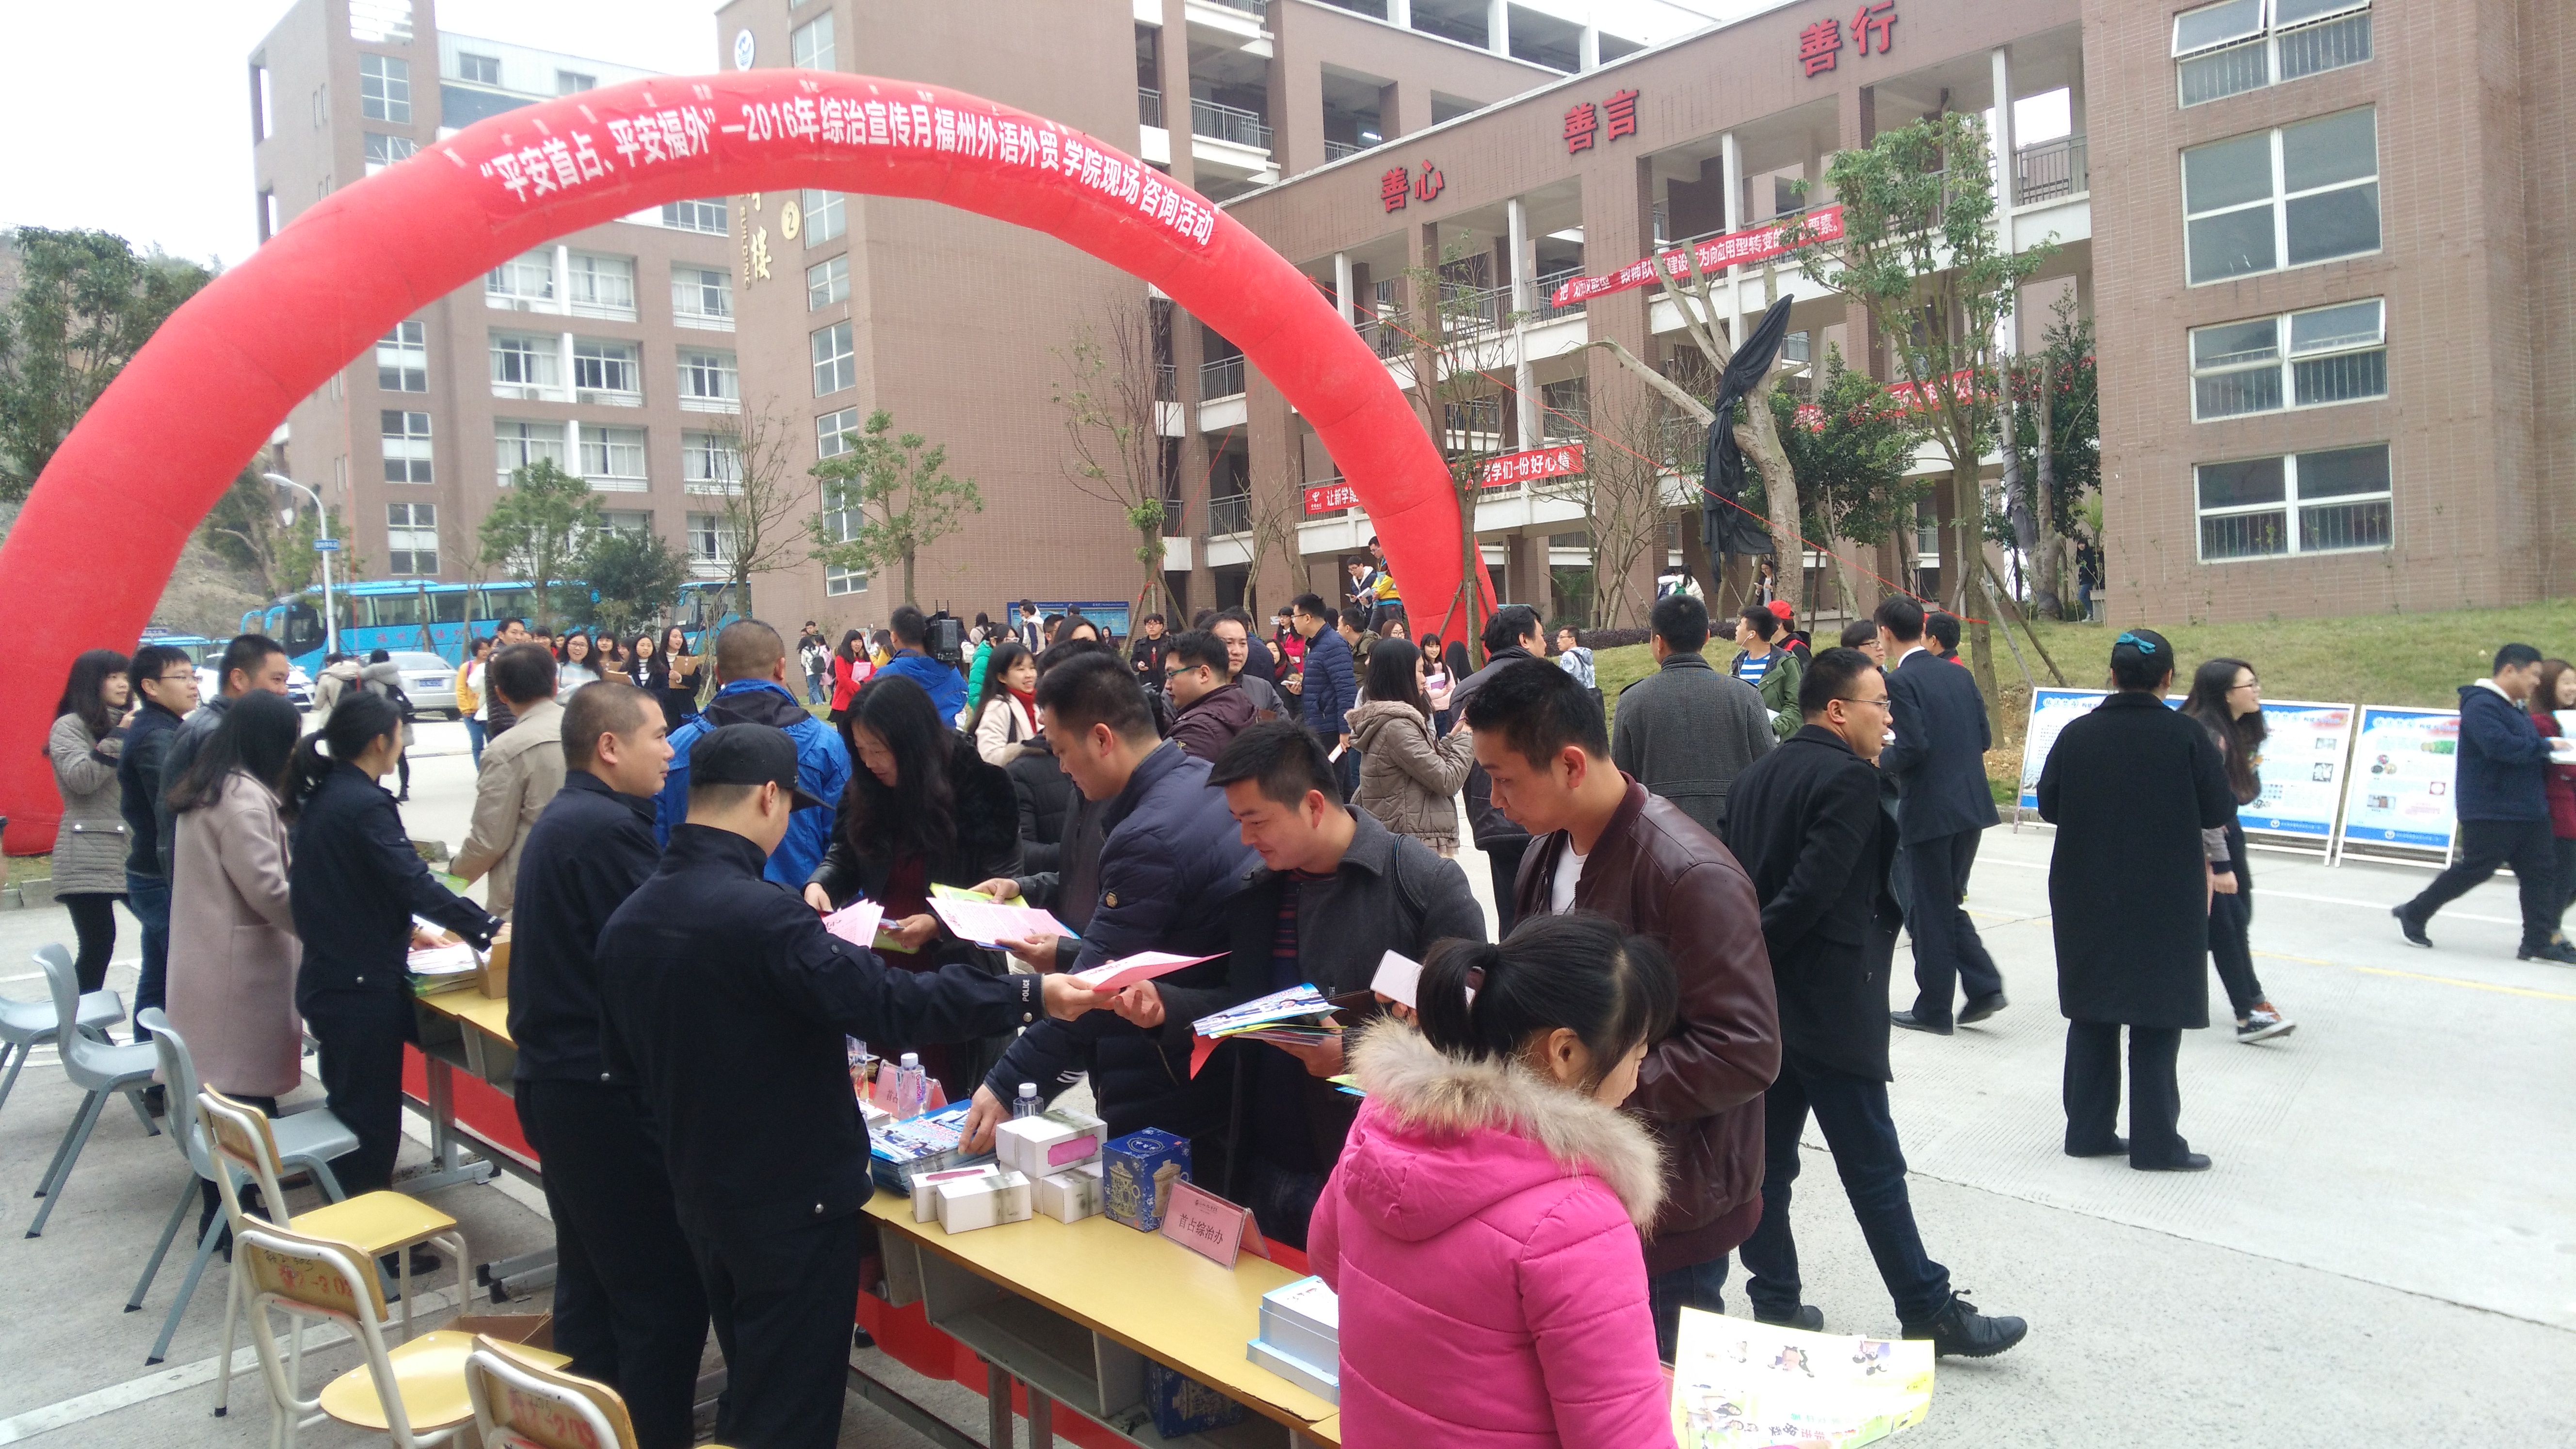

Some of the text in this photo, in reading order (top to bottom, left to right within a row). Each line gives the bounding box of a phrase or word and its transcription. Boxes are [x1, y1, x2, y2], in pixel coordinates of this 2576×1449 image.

[1380, 0, 1898, 213] 善心 善言 善行
[788, 211, 794, 231] 2
[1022, 979, 1030, 1002] POLICE
[1179, 1213, 1224, 1245] 首占综治办
